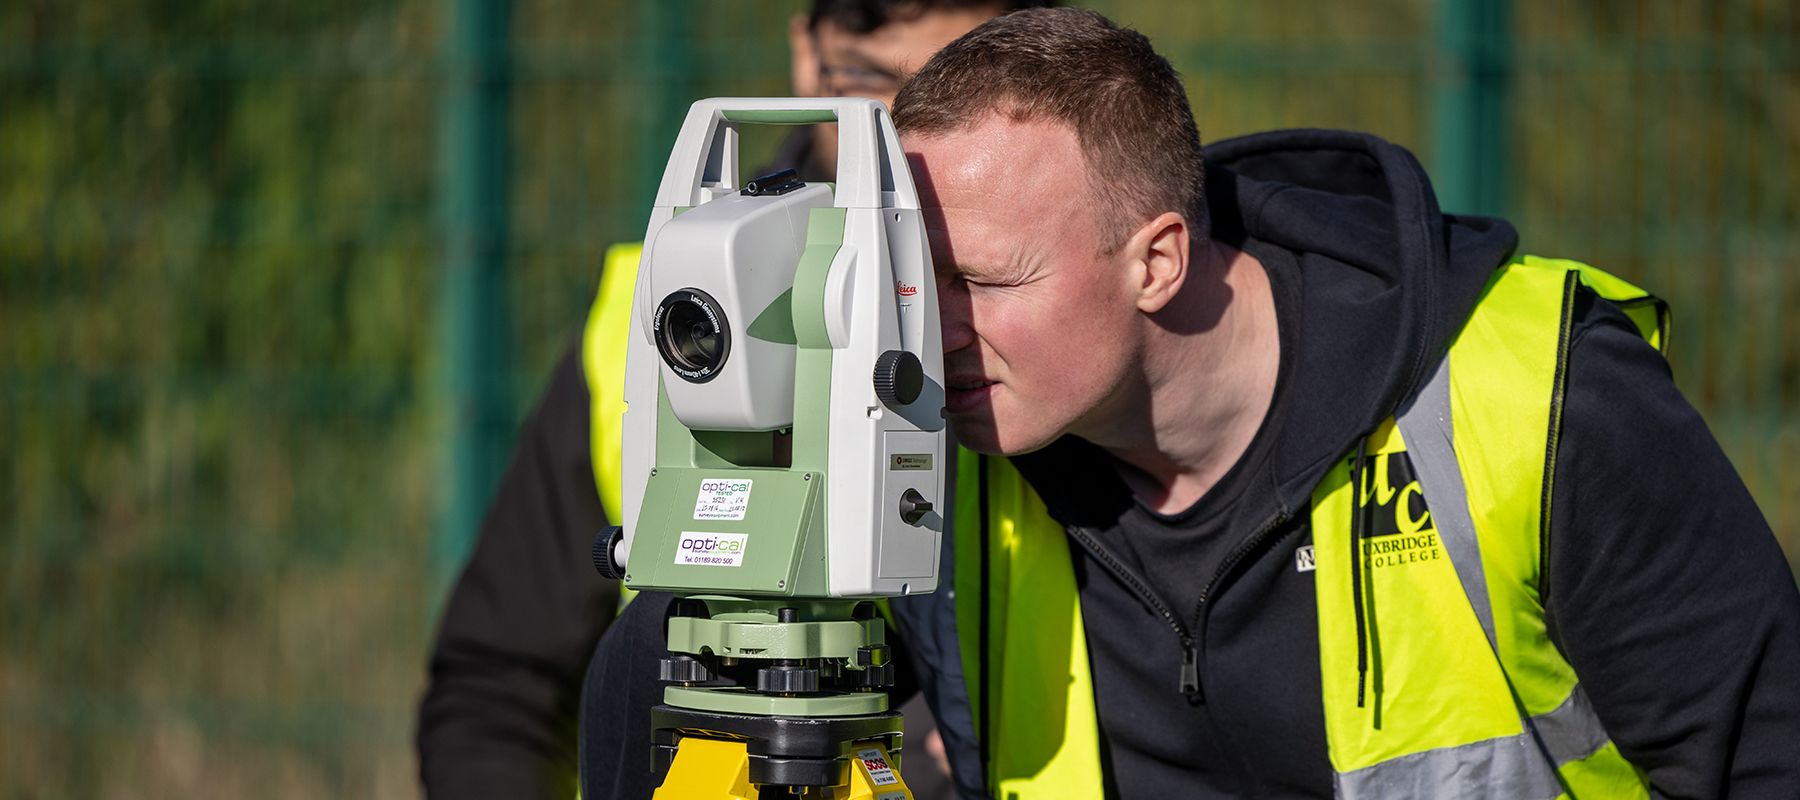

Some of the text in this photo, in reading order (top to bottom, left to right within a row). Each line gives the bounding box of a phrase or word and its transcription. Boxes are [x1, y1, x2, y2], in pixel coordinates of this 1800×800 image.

[897, 280, 917, 296] Leica
[690, 294, 720, 334] Leica Geosystems
[1362, 534, 1438, 557] UXBRIDGE
[1365, 549, 1440, 570] COLLEGE
